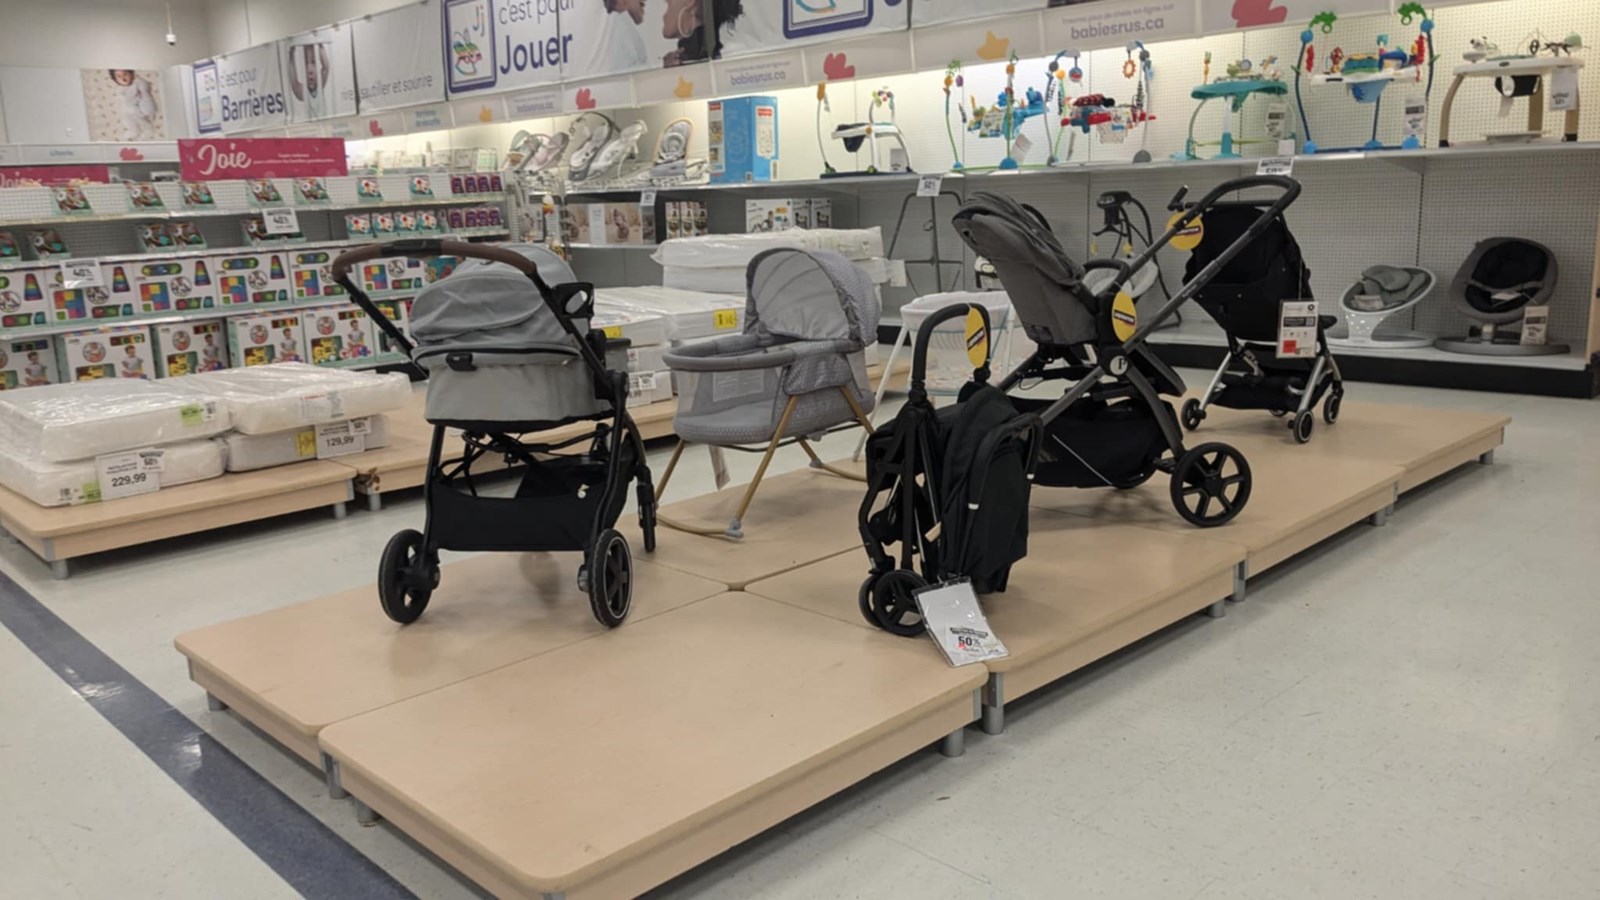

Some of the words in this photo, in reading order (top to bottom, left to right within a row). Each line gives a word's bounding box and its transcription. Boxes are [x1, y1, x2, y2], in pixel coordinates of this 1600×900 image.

[1070, 17, 1165, 40] babiesrus.ca
[499, 34, 573, 75] Jouer
[221, 88, 284, 122] Barrières
[198, 144, 252, 175] Joie
[111, 473, 147, 488] 229,99
